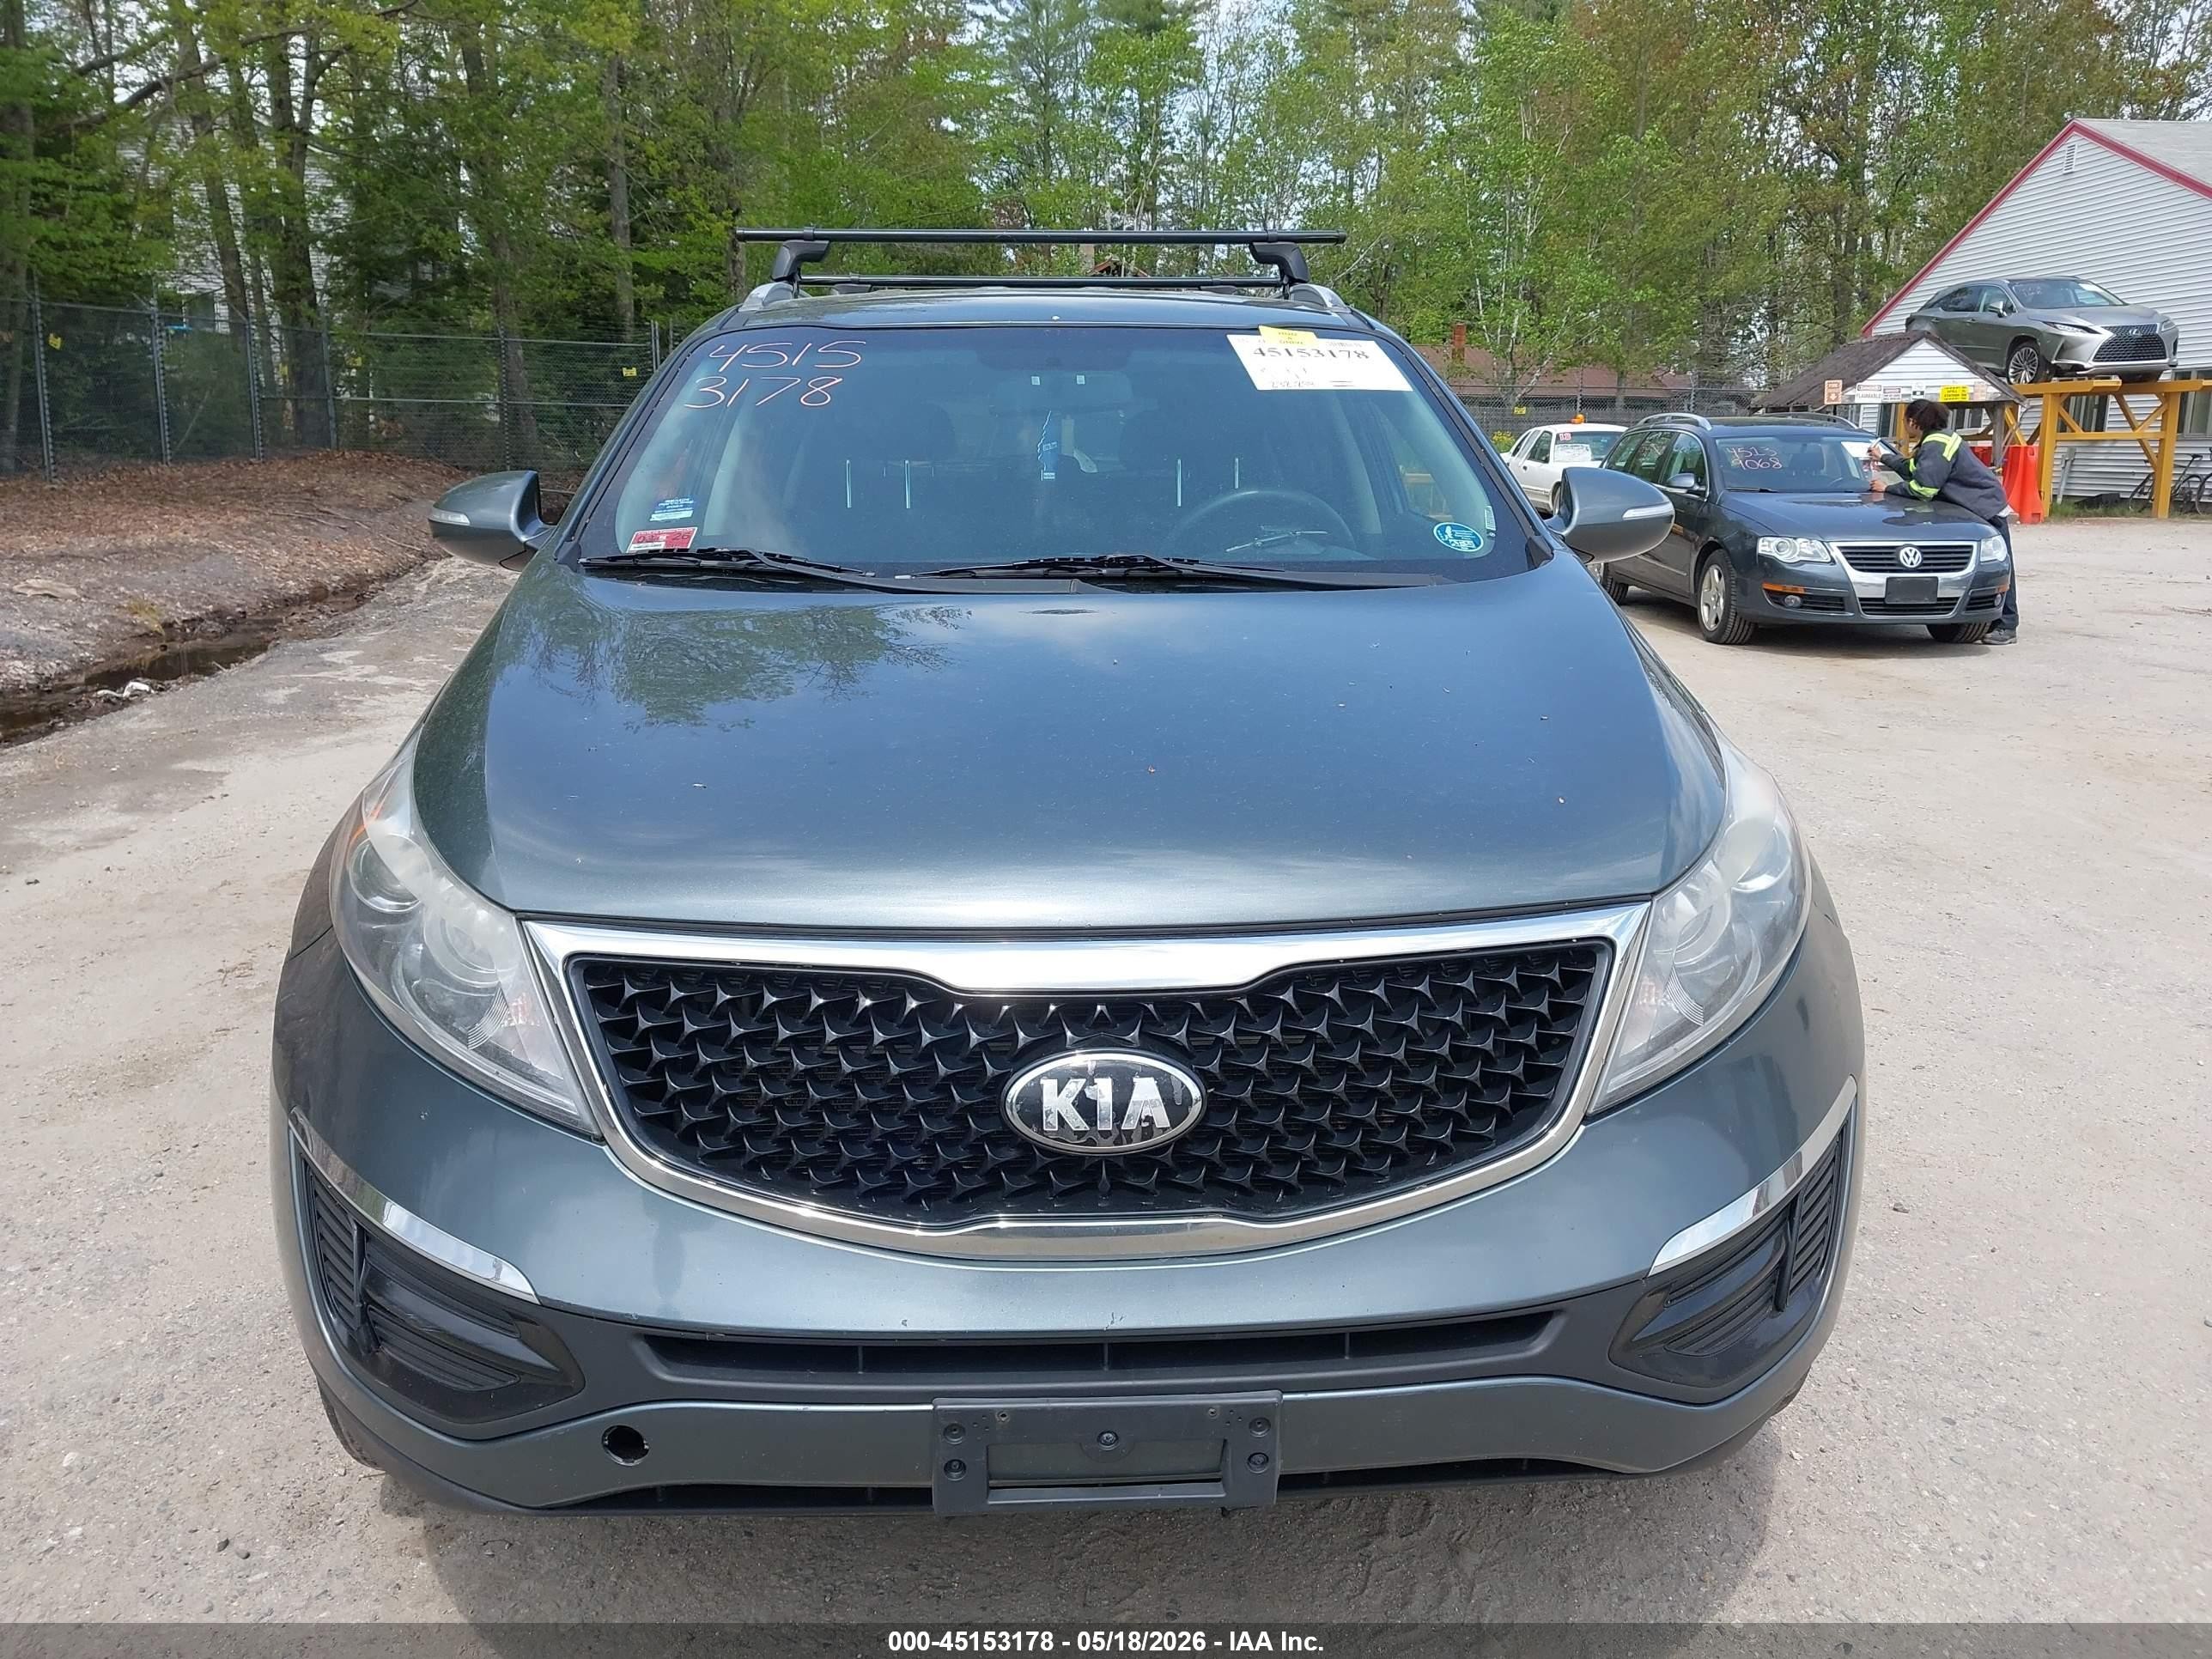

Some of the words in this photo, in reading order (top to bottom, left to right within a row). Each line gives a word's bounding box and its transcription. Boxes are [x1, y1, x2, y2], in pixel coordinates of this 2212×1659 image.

[708, 340, 866, 373] 4515
[1253, 347, 1370, 360] 45153178
[684, 376, 843, 409] 3178
[1730, 457, 1783, 471] 9068
[1040, 1077, 1171, 1131] KIA
